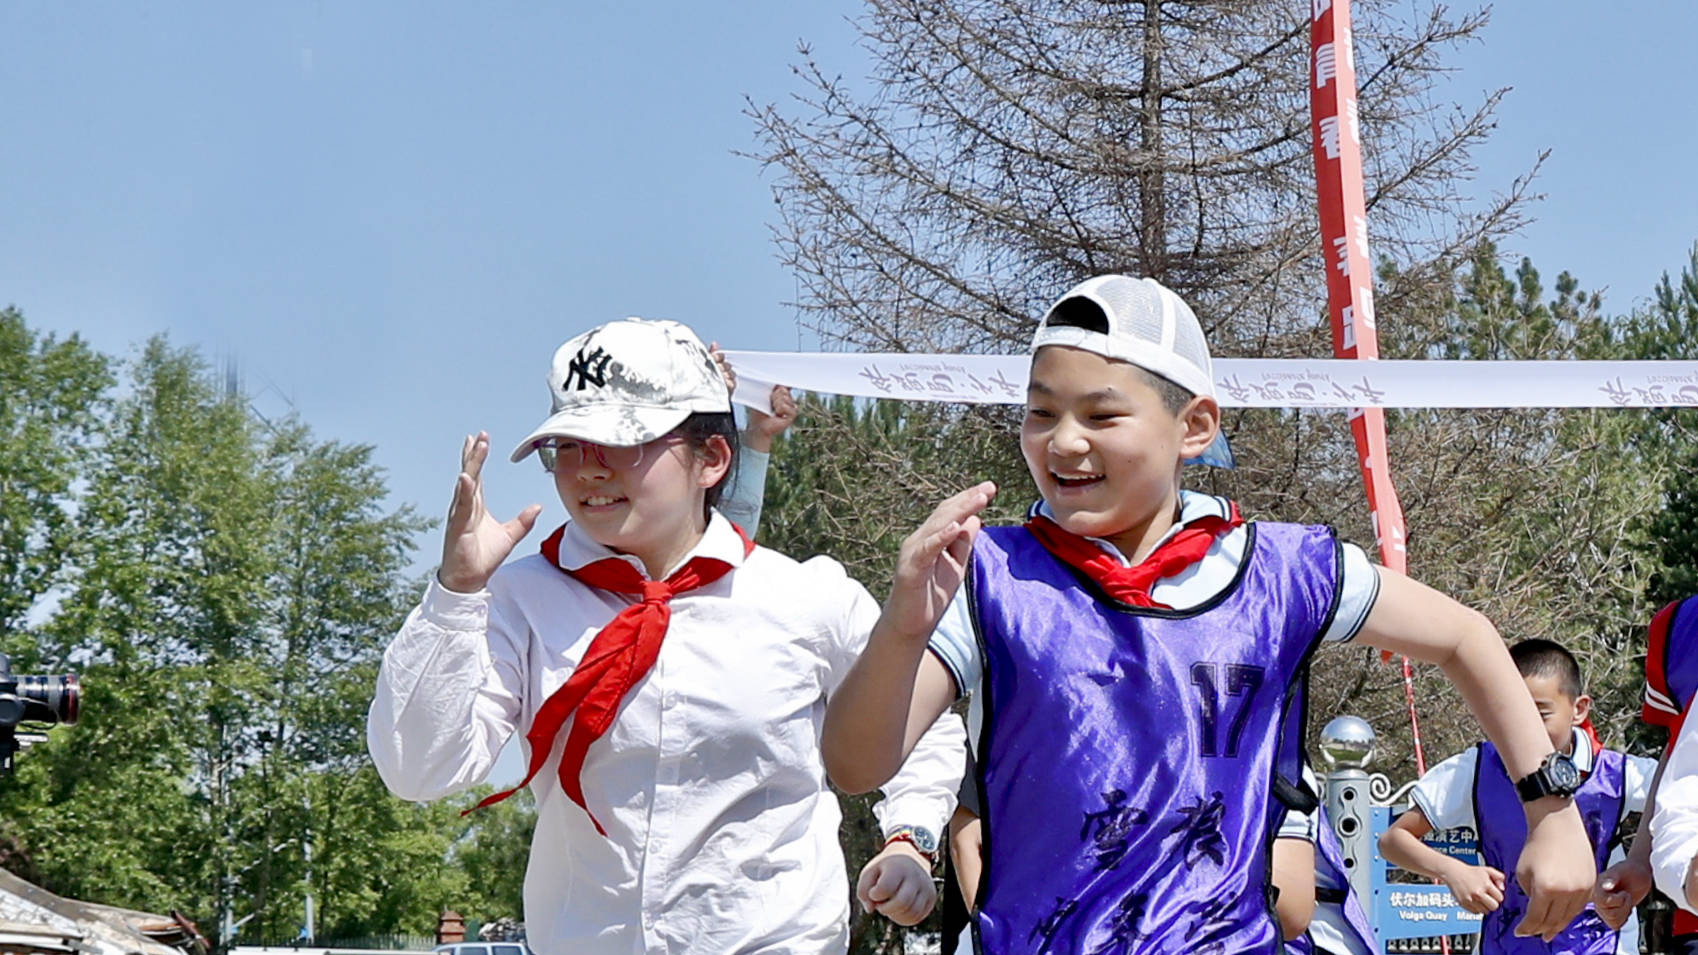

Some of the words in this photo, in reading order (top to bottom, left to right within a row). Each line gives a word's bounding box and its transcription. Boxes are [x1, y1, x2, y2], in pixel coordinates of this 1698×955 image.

[1190, 661, 1265, 758] 17
[1399, 910, 1424, 922] Volga
[1425, 910, 1448, 921] Quay
